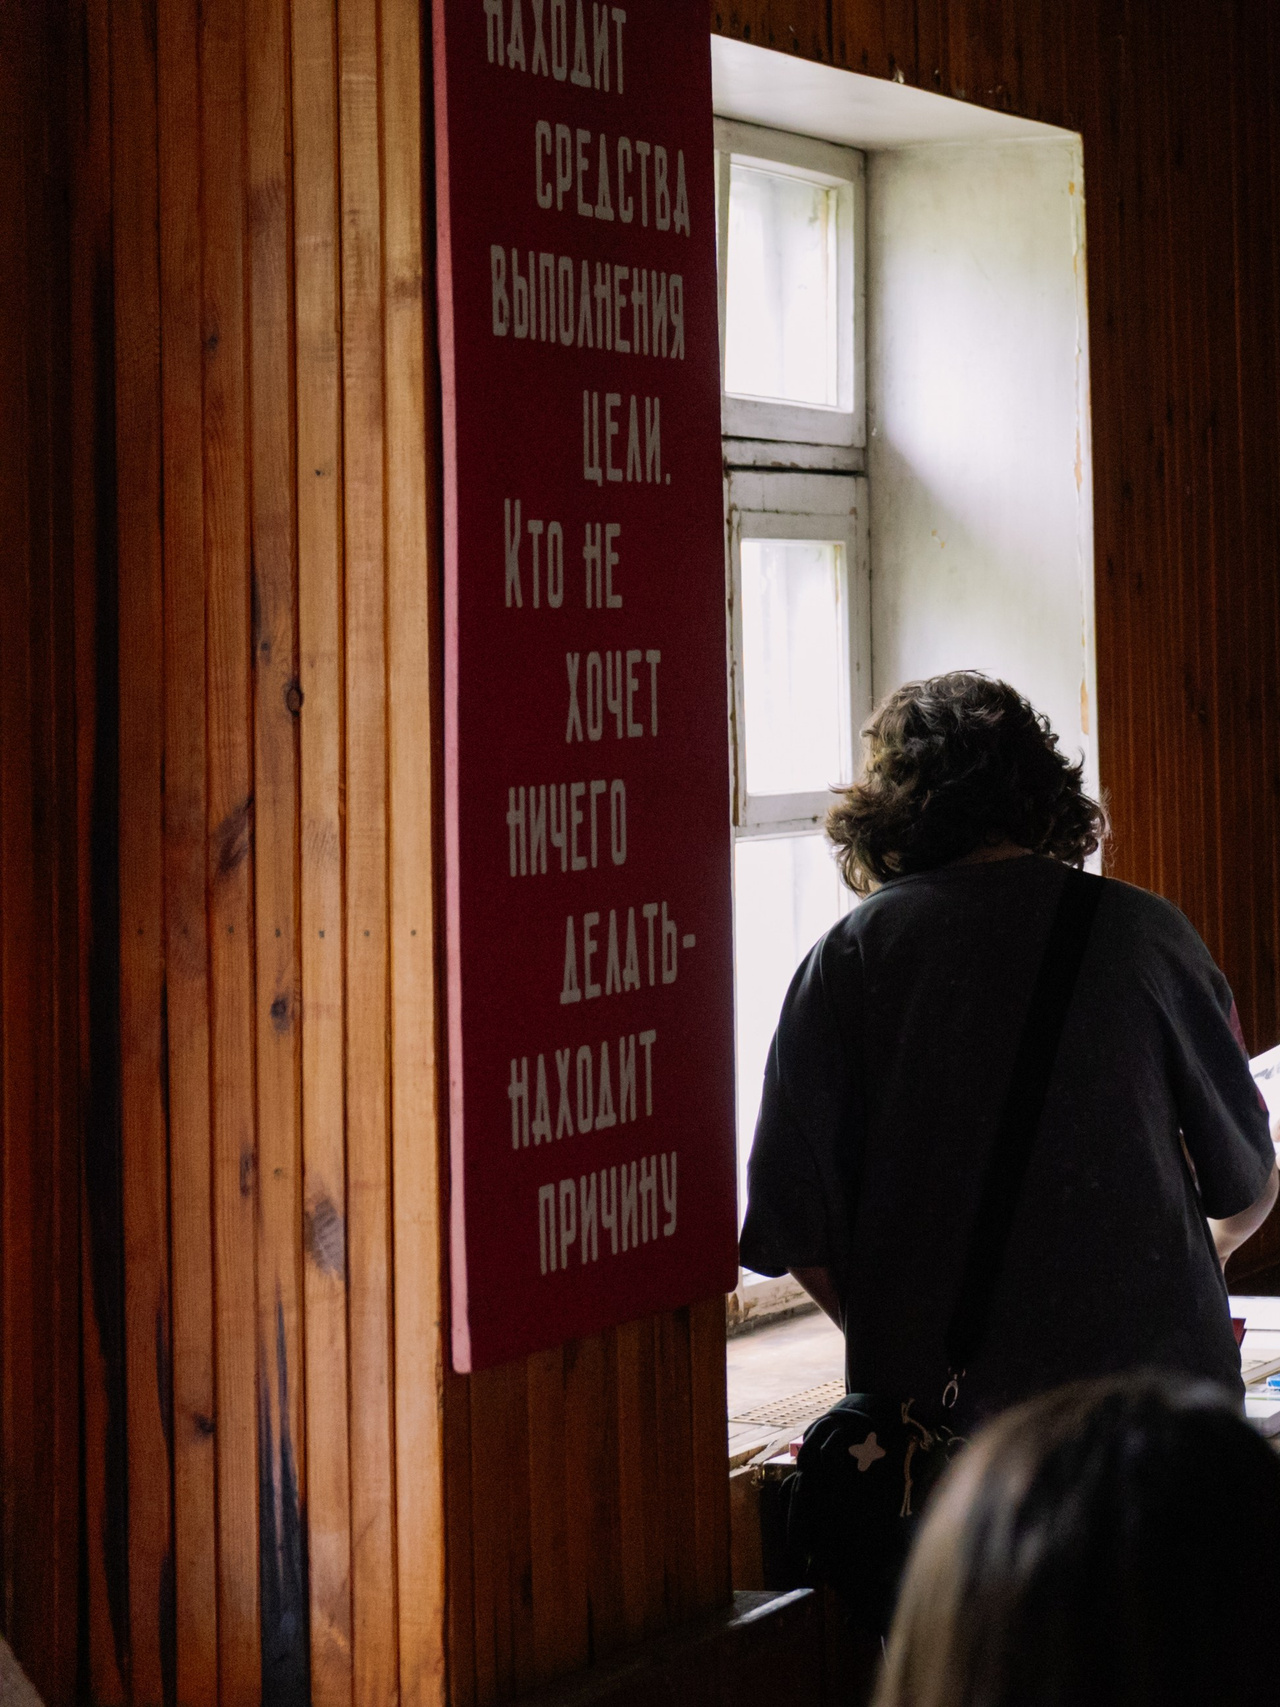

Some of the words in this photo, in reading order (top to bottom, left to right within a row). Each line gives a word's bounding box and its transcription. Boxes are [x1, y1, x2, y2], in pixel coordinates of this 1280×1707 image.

[483, 0, 626, 94] НАХОДИТ
[535, 120, 690, 237] СРЕДСТВА
[490, 244, 685, 360] ВЫПОЛНЕНИЯ
[583, 390, 671, 486] ЦЕЛИ.
[583, 523, 623, 609] НЕ
[565, 649, 661, 743] ХОЧЕТ
[506, 778, 627, 877] НИЧЕГО
[508, 1029, 657, 1150] НАХОДИТ
[538, 1151, 678, 1275] ПРИЧИНУ
